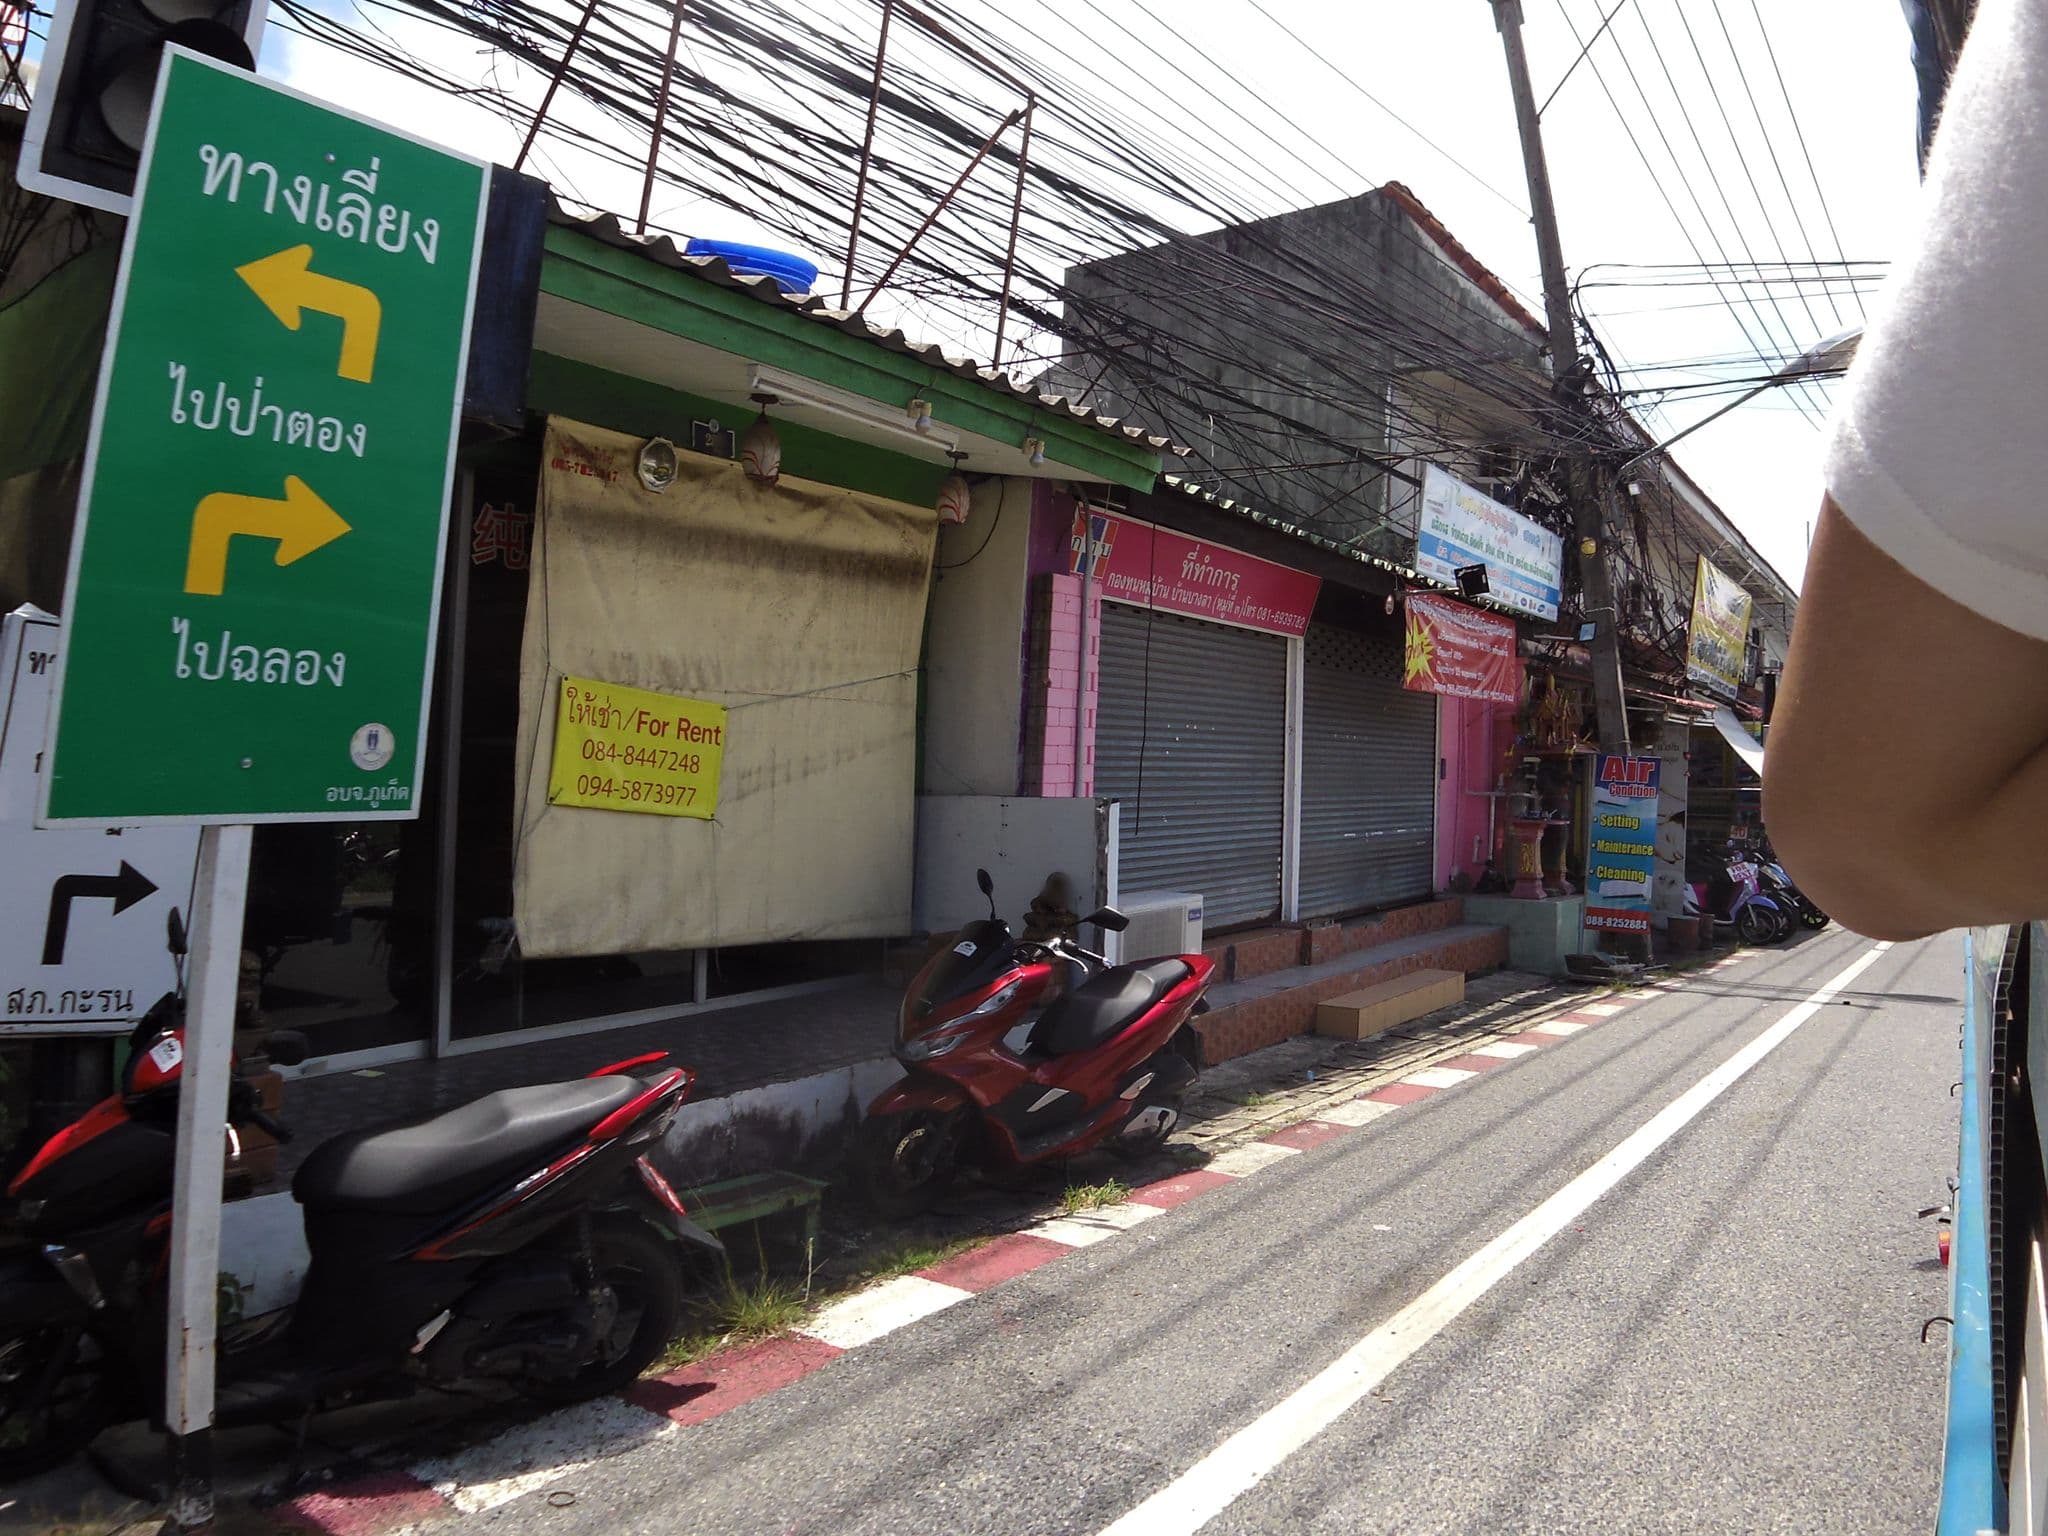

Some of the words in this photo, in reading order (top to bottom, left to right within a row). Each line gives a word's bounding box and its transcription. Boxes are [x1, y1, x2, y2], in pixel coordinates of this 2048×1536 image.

[198, 143, 441, 265] ทางเลี่ยง
[168, 361, 366, 458] ไปป่าตอง
[1181, 544, 1240, 591] ที่ทำการ
[1107, 573, 1170, 603] กองทุนหมู่บ้าน
[171, 617, 346, 687] ไปฉลอง
[677, 717, 721, 747] Rent
[582, 738, 700, 774] 084-8447248
[1600, 755, 1655, 783] Air
[326, 778, 410, 808] อบจ.ภูเก็ต
[577, 774, 696, 807] 094-5873977
[1609, 783, 1656, 798] Condition
[1600, 814, 1639, 830] Setting
[1596, 865, 1645, 883] Cleaning
[7, 987, 134, 1014] สภ.กะรน
